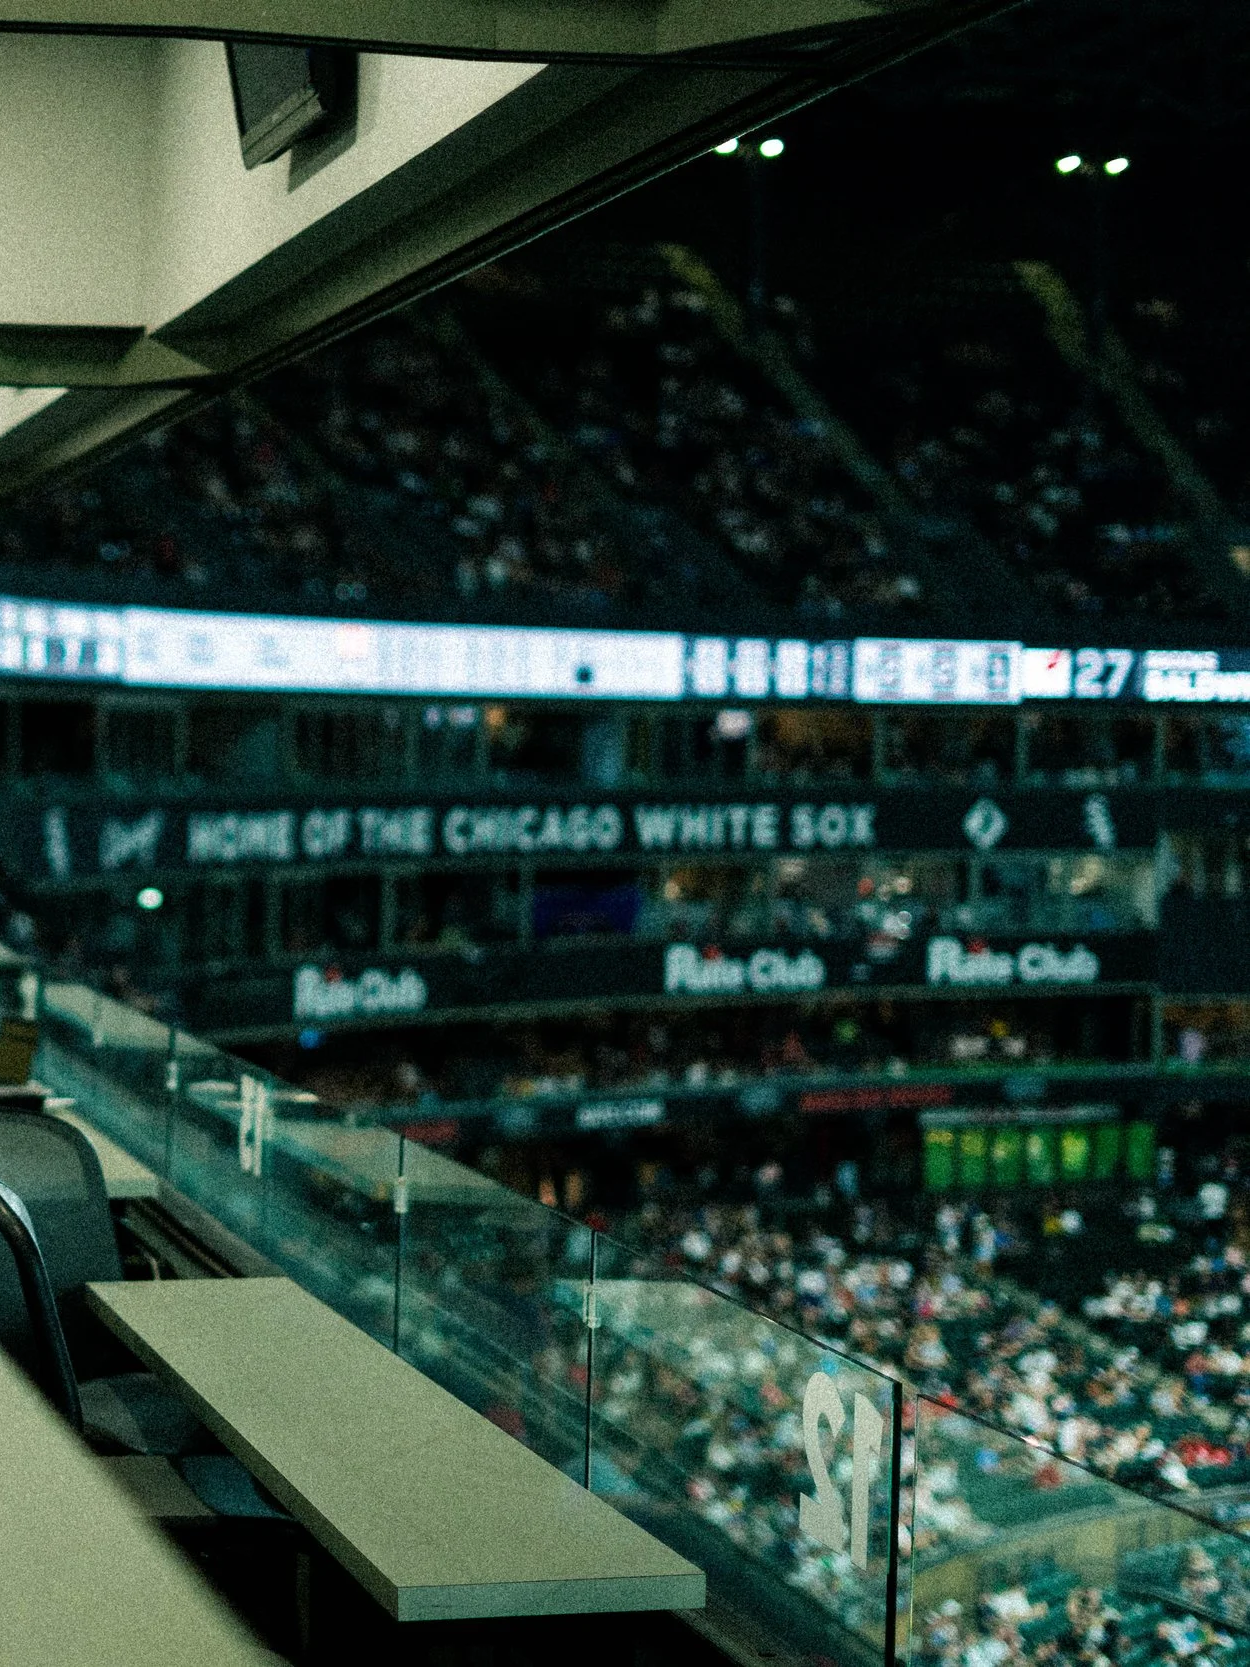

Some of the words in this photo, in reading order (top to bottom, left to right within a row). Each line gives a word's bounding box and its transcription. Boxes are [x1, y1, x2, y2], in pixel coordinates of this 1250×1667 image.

[1074, 647, 1134, 699] 27
[188, 811, 295, 860] HOME
[302, 809, 351, 856] OF
[356, 806, 433, 853] THE
[444, 804, 623, 852] CHICAGO
[634, 802, 779, 848] WHITE
[790, 803, 875, 848] SOX
